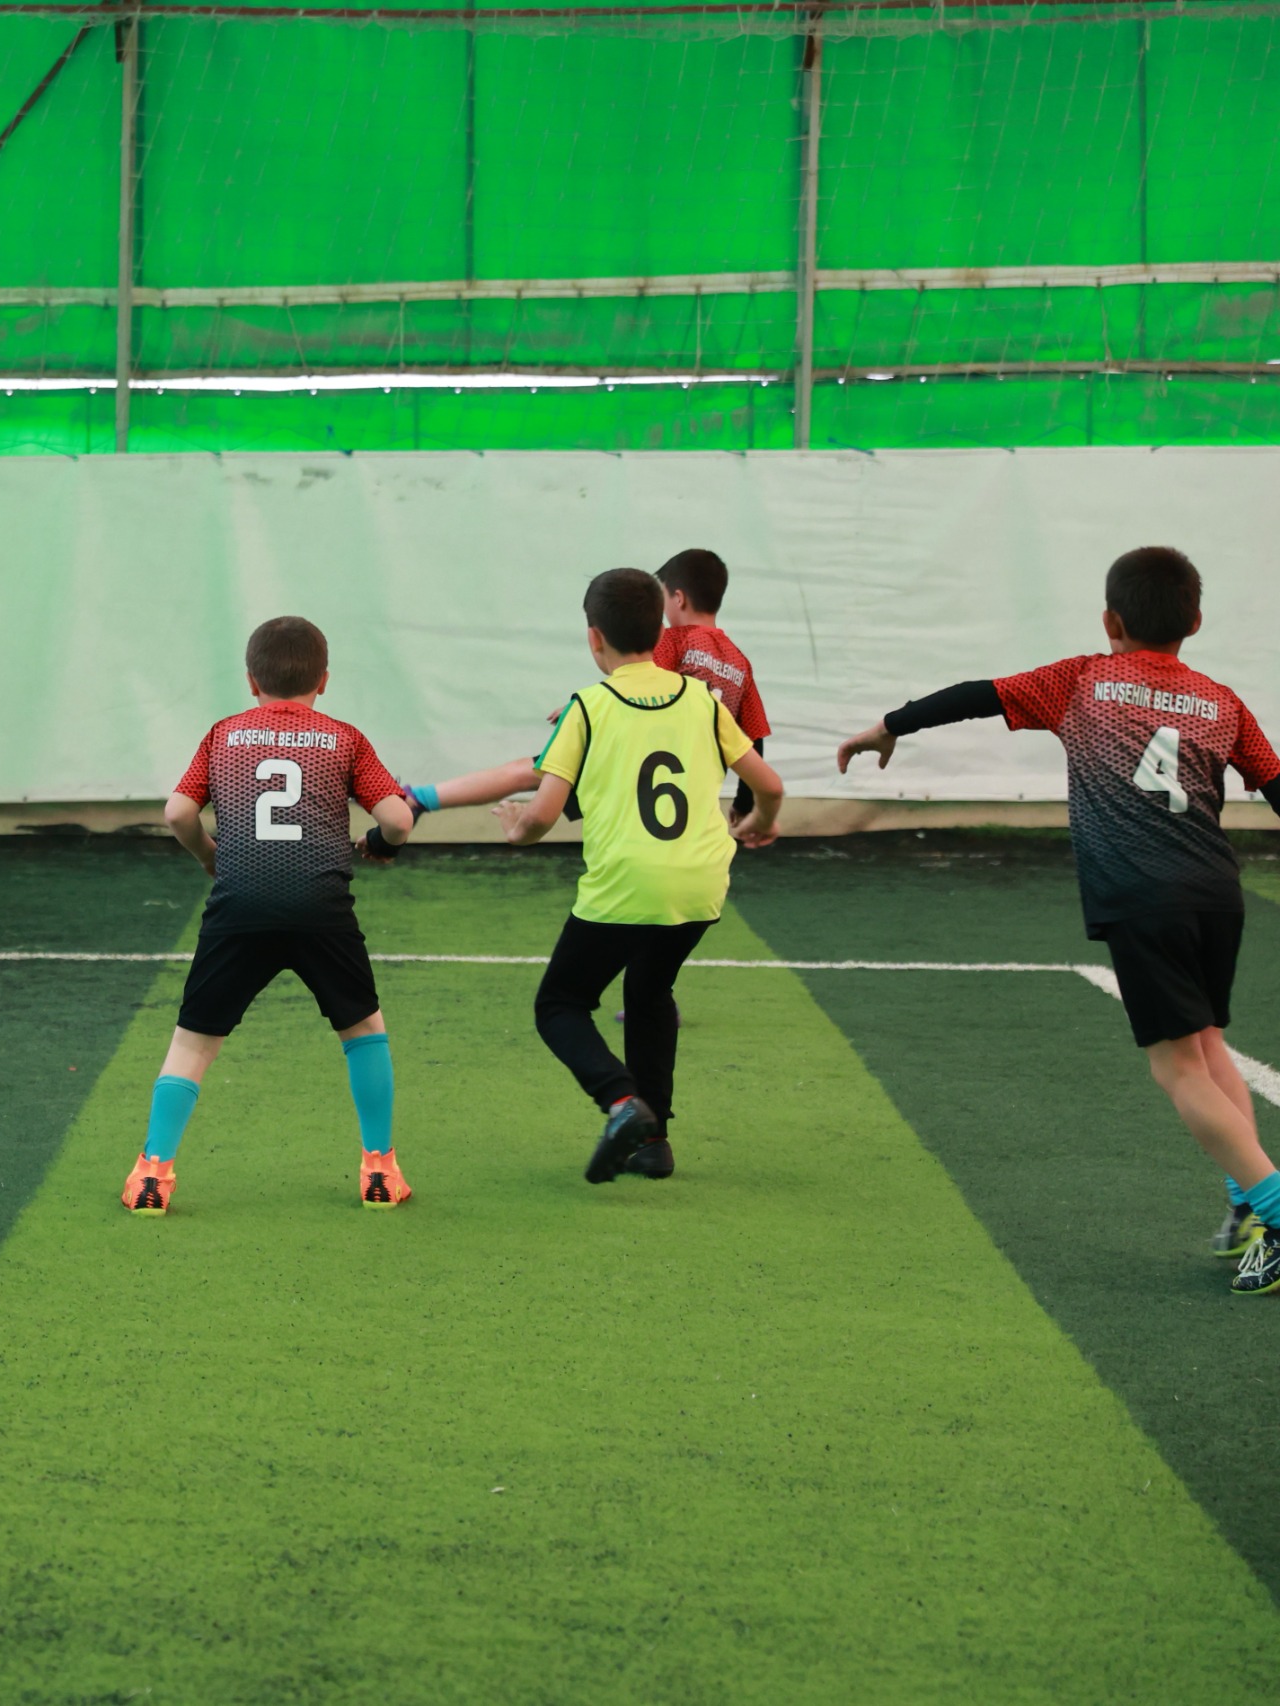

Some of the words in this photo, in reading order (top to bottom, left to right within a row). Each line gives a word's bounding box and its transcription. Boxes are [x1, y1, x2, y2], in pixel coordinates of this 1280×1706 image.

[227, 727, 276, 749] NEVŞEHİR
[278, 728, 337, 751] BELEDİYESİ
[1094, 682, 1151, 707] NEVŞEHİR
[1153, 690, 1218, 721] BELEDİYESİ
[255, 758, 303, 841] 2
[637, 751, 689, 841] 6
[1132, 726, 1188, 814] 4
